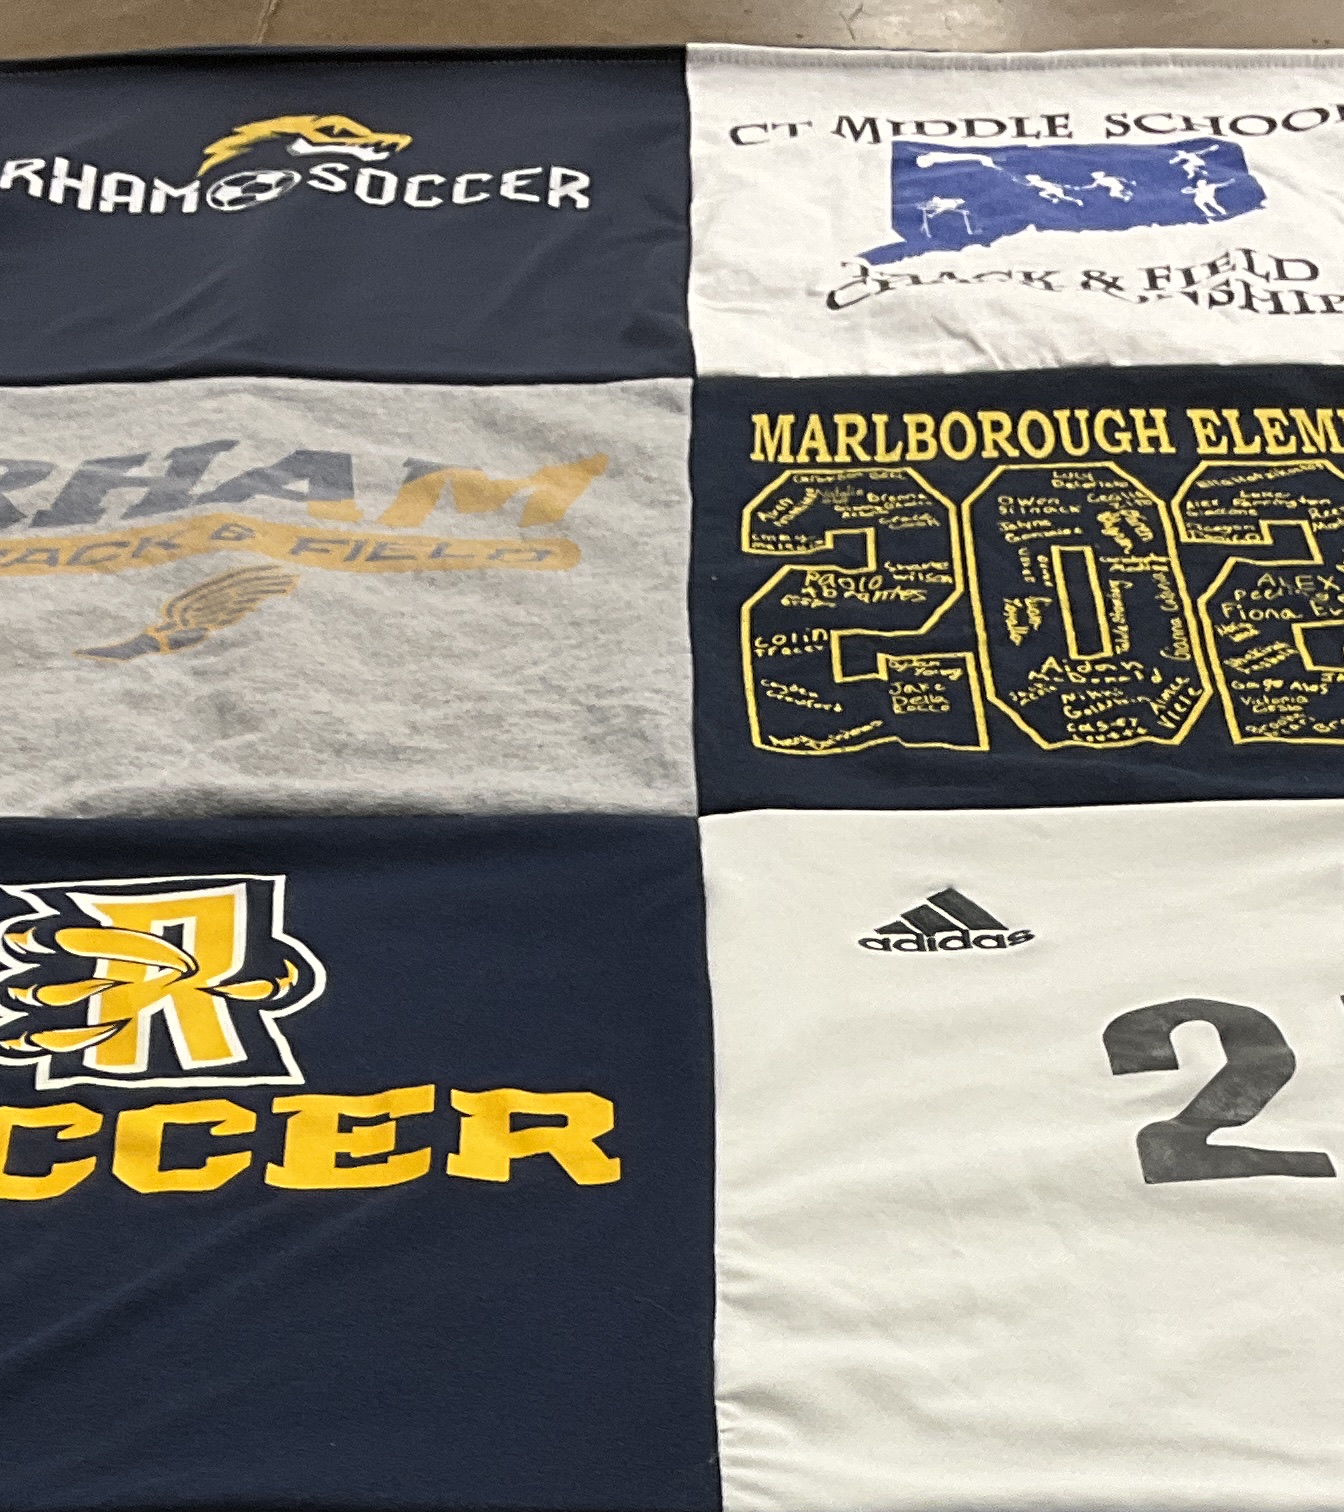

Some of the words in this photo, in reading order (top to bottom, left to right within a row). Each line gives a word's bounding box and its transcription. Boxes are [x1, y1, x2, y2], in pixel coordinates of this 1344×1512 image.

[729, 121, 813, 147] CT
[831, 113, 1074, 146] MIDDLE
[306, 161, 591, 211] SOCCER
[1138, 247, 1321, 291] FIELD
[750, 407, 1177, 464] MARLBOROUGH
[288, 535, 554, 564] FIELD
[1221, 601, 1304, 622] Fiona
[857, 928, 1037, 954] adidas
